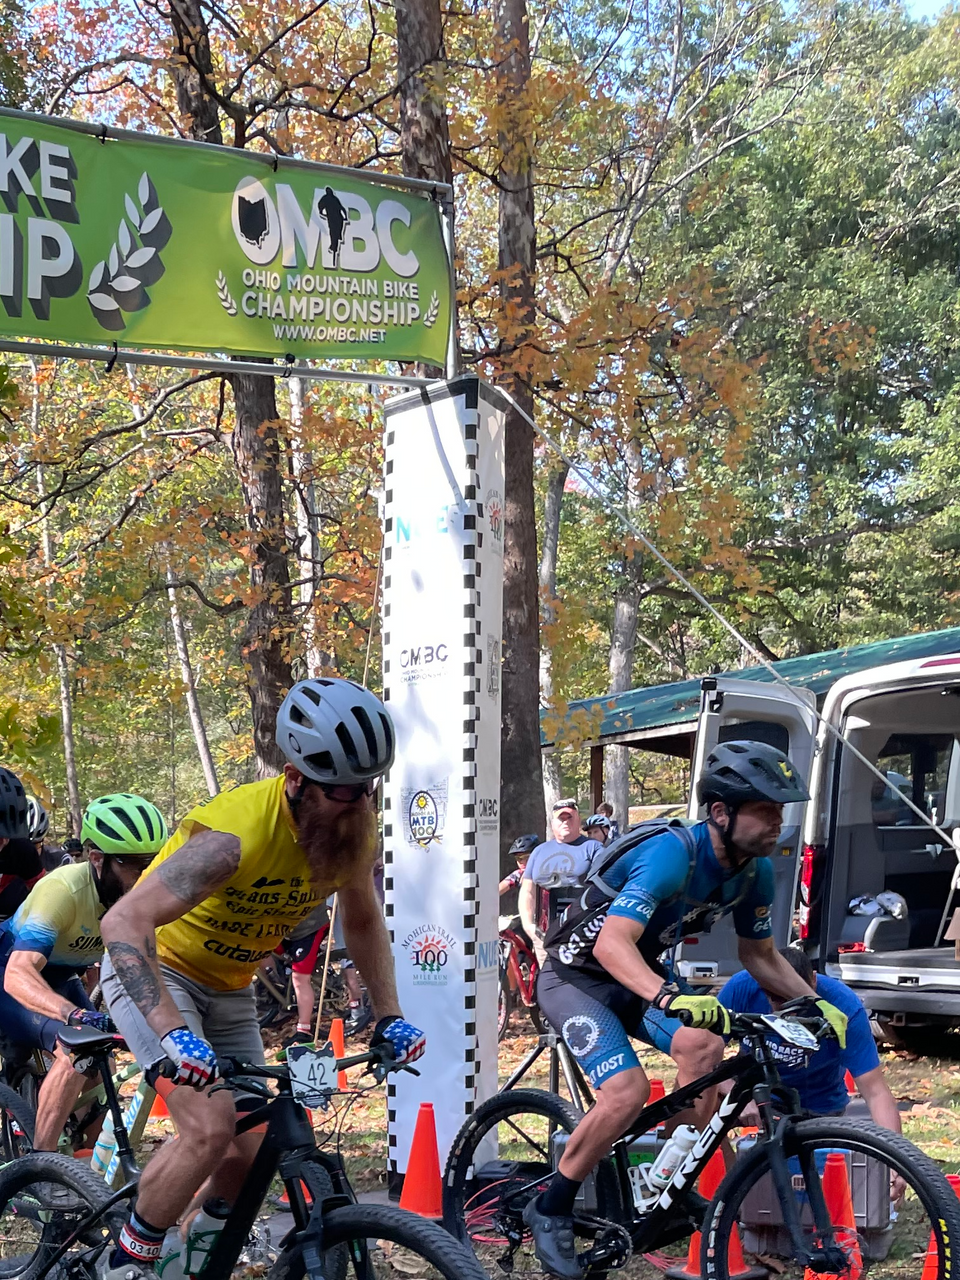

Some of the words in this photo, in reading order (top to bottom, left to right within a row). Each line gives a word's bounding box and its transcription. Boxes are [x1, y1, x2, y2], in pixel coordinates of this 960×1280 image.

[230, 175, 421, 278] OMBC
[242, 267, 281, 292] OHIO
[286, 272, 379, 297] MOUNTAIN
[383, 279, 419, 301] BIKE
[241, 292, 421, 326] CHAMPIONSHIP
[272, 322, 387, 344] WWW.OMBC.NET
[412, 815, 435, 827] MTB
[613, 896, 634, 910] GET
[401, 924, 437, 950] MOHICAN
[437, 926, 458, 950] TRAIL
[412, 949, 449, 967] 100
[308, 1063, 327, 1086] 42
[596, 1053, 625, 1078] LOST
[126, 1092, 144, 1133] RUZ
[653, 1091, 738, 1210] TREK
